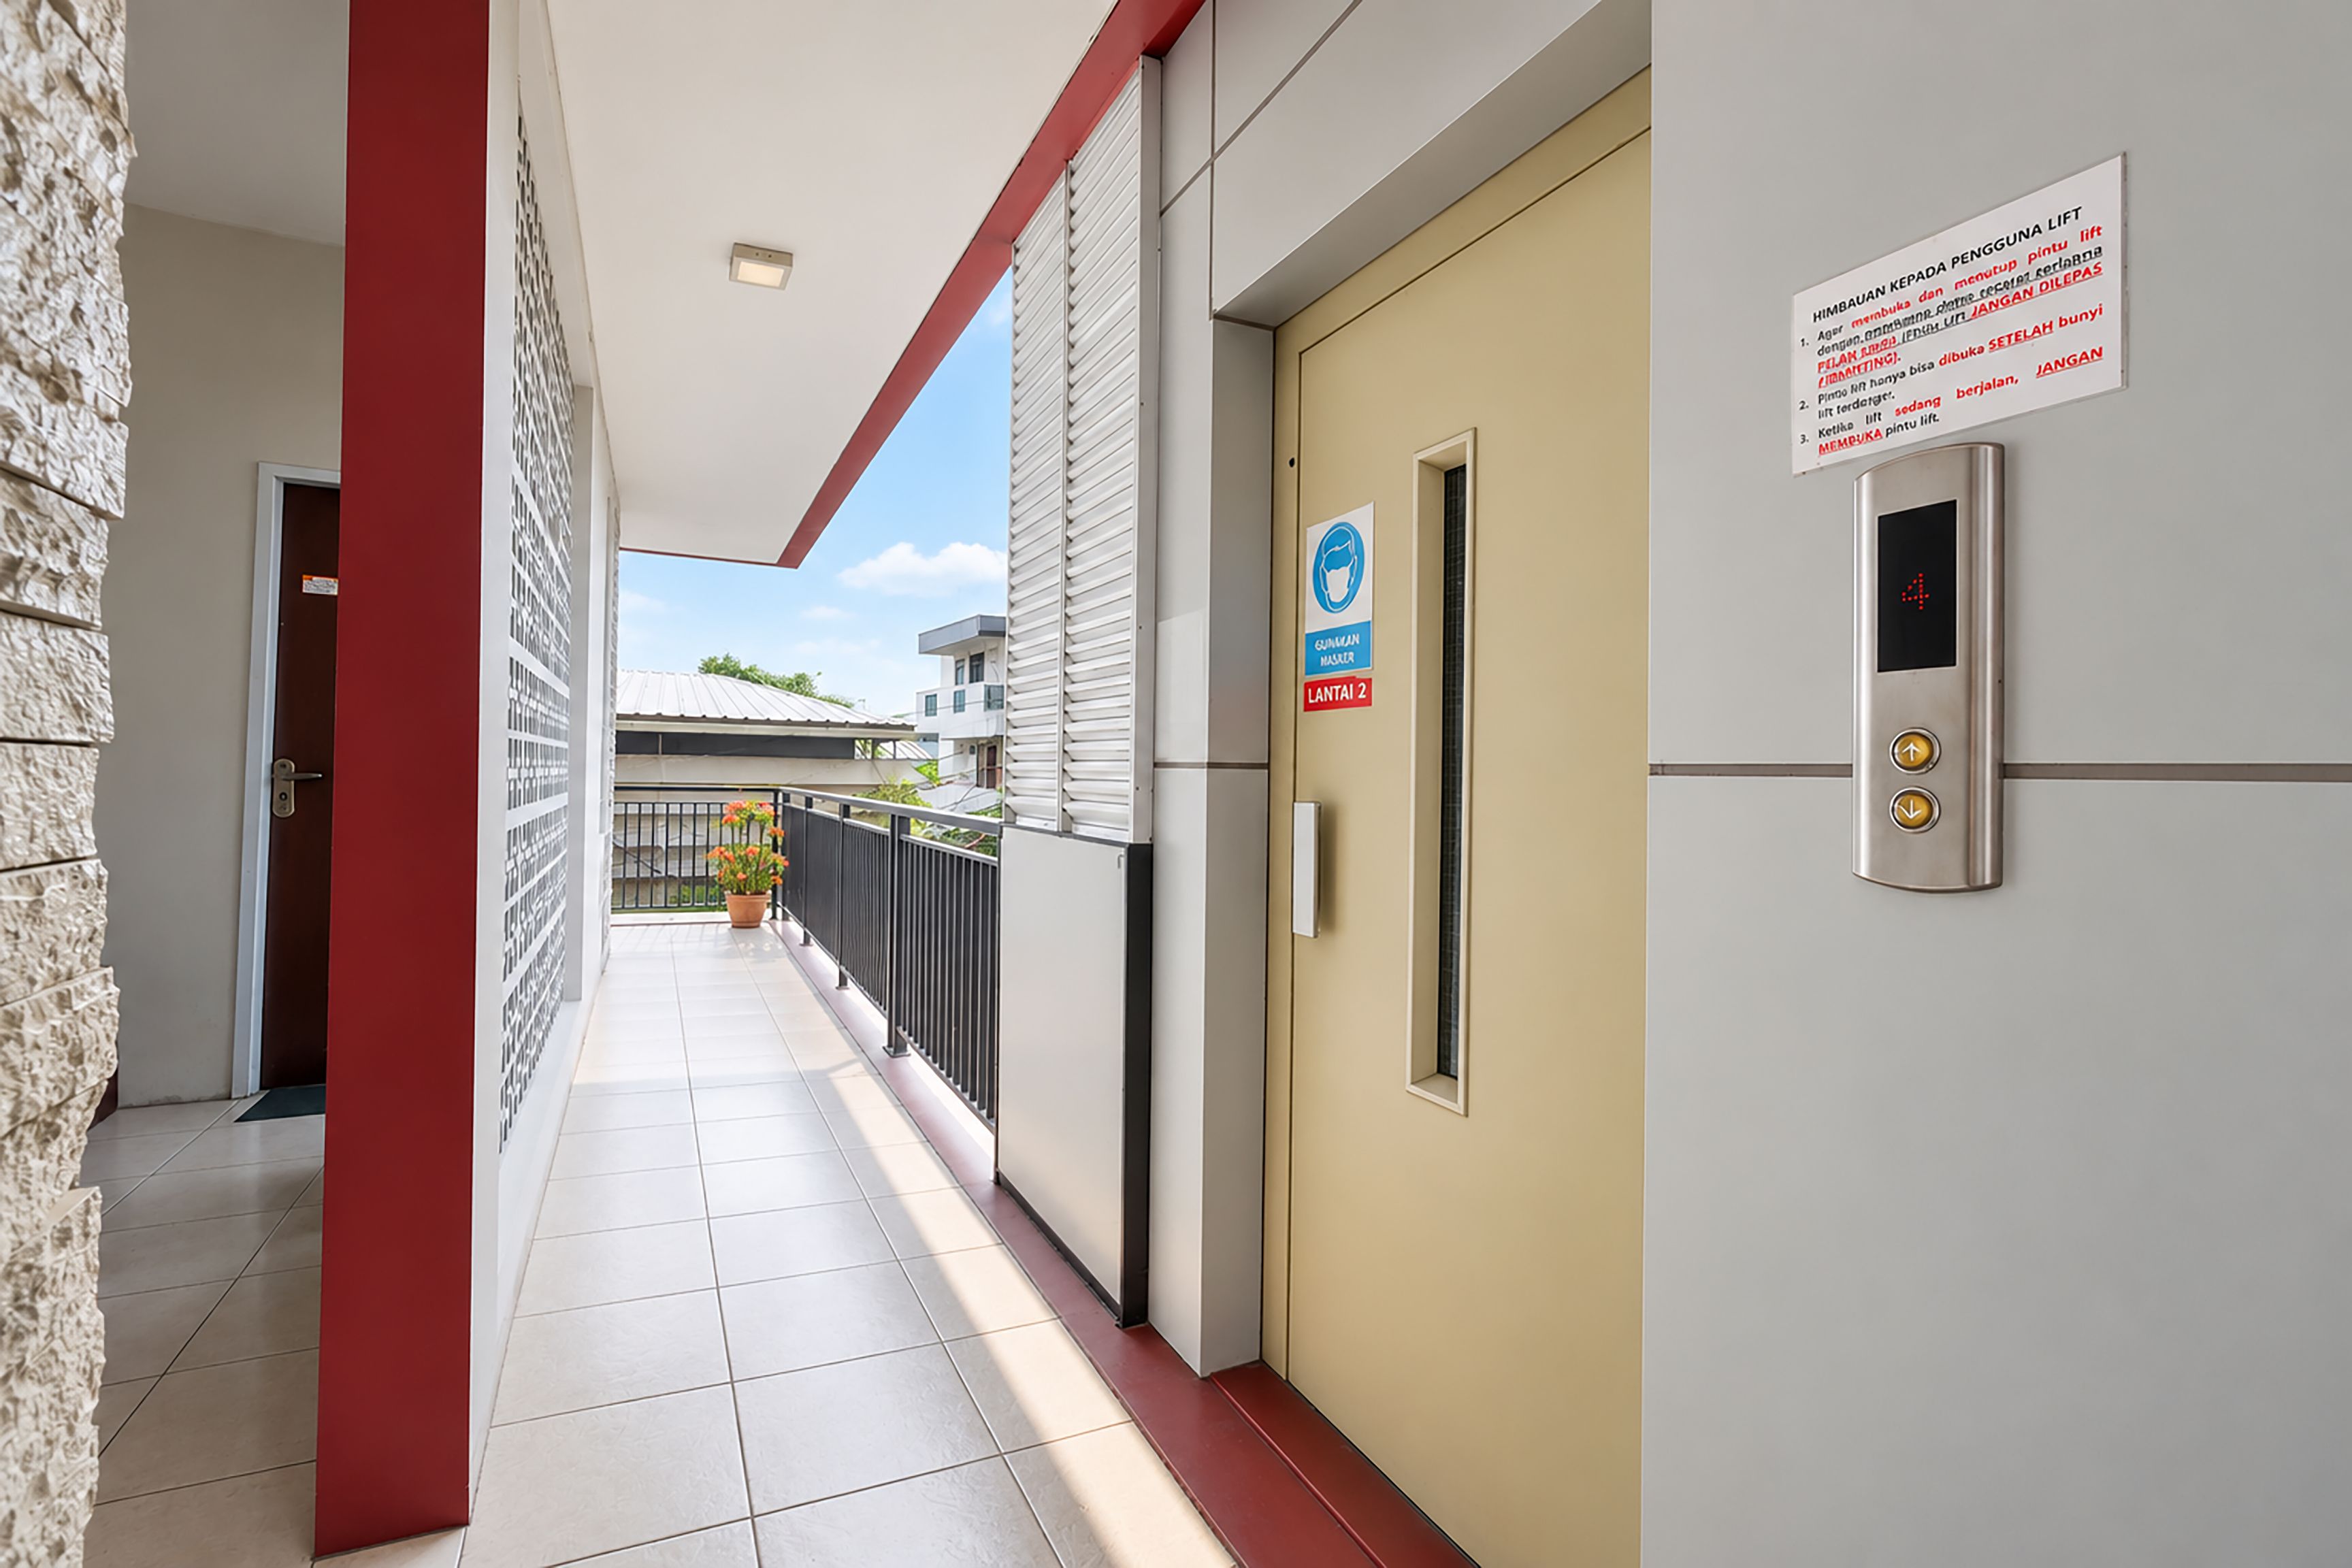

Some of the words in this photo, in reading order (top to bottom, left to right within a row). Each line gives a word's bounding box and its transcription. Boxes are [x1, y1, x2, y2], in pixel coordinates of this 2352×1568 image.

[1813, 285, 1885, 323] HIMBAUAN
[1890, 262, 1946, 293] KEPADA
[1951, 224, 2042, 269] PENGGUNA
[2048, 206, 2082, 231] LIFT
[1918, 287, 1944, 304] dan
[2028, 240, 2068, 265] pintu
[2080, 225, 2102, 242] lift
[1971, 287, 2034, 320] JANGAN
[2039, 261, 2103, 295] DILEPAS
[1910, 361, 1935, 376] bisa
[1939, 345, 1984, 367] dibuka
[1988, 321, 2054, 353] SETELAH
[2059, 304, 2103, 328] bunyi
[1956, 375, 2019, 400] berjalan,
[2036, 346, 2104, 378] JANGAN
[1885, 418, 1917, 439] pintu
[1921, 412, 1940, 427] lift.
[1901, 573, 1930, 610] 4
[1308, 683, 1354, 704] LANTAI
[1358, 682, 1367, 699] 2
